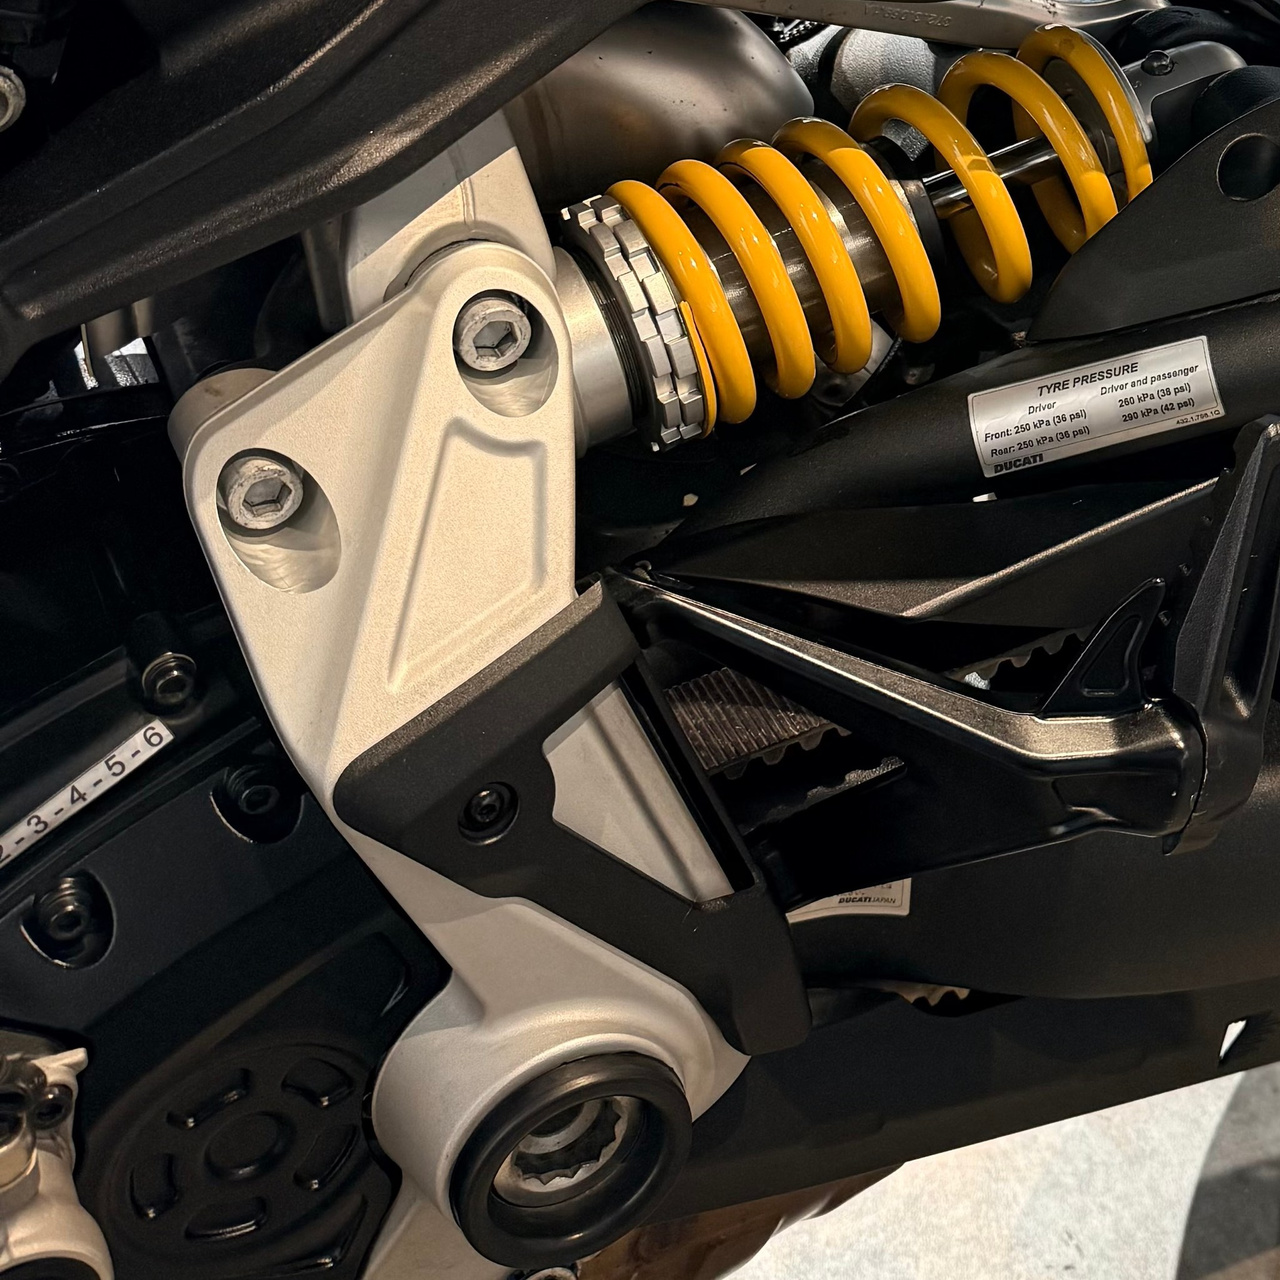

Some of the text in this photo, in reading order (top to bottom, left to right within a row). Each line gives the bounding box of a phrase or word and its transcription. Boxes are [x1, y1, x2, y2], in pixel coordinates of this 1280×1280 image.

[1037, 362, 1139, 397] TYRE PRESSURE
[1100, 364, 1199, 396] Driver and passenger
[1028, 400, 1057, 415] Driver
[1118, 382, 1191, 408] 260 kPa (38 psi)
[1122, 397, 1195, 423] 290 kPa (42 psi)
[984, 408, 1087, 443] Front: 250 kPa (36 psi)
[990, 425, 1090, 458] Rear: 250 kPa (36 psi)
[994, 453, 1043, 474] DUCATI
